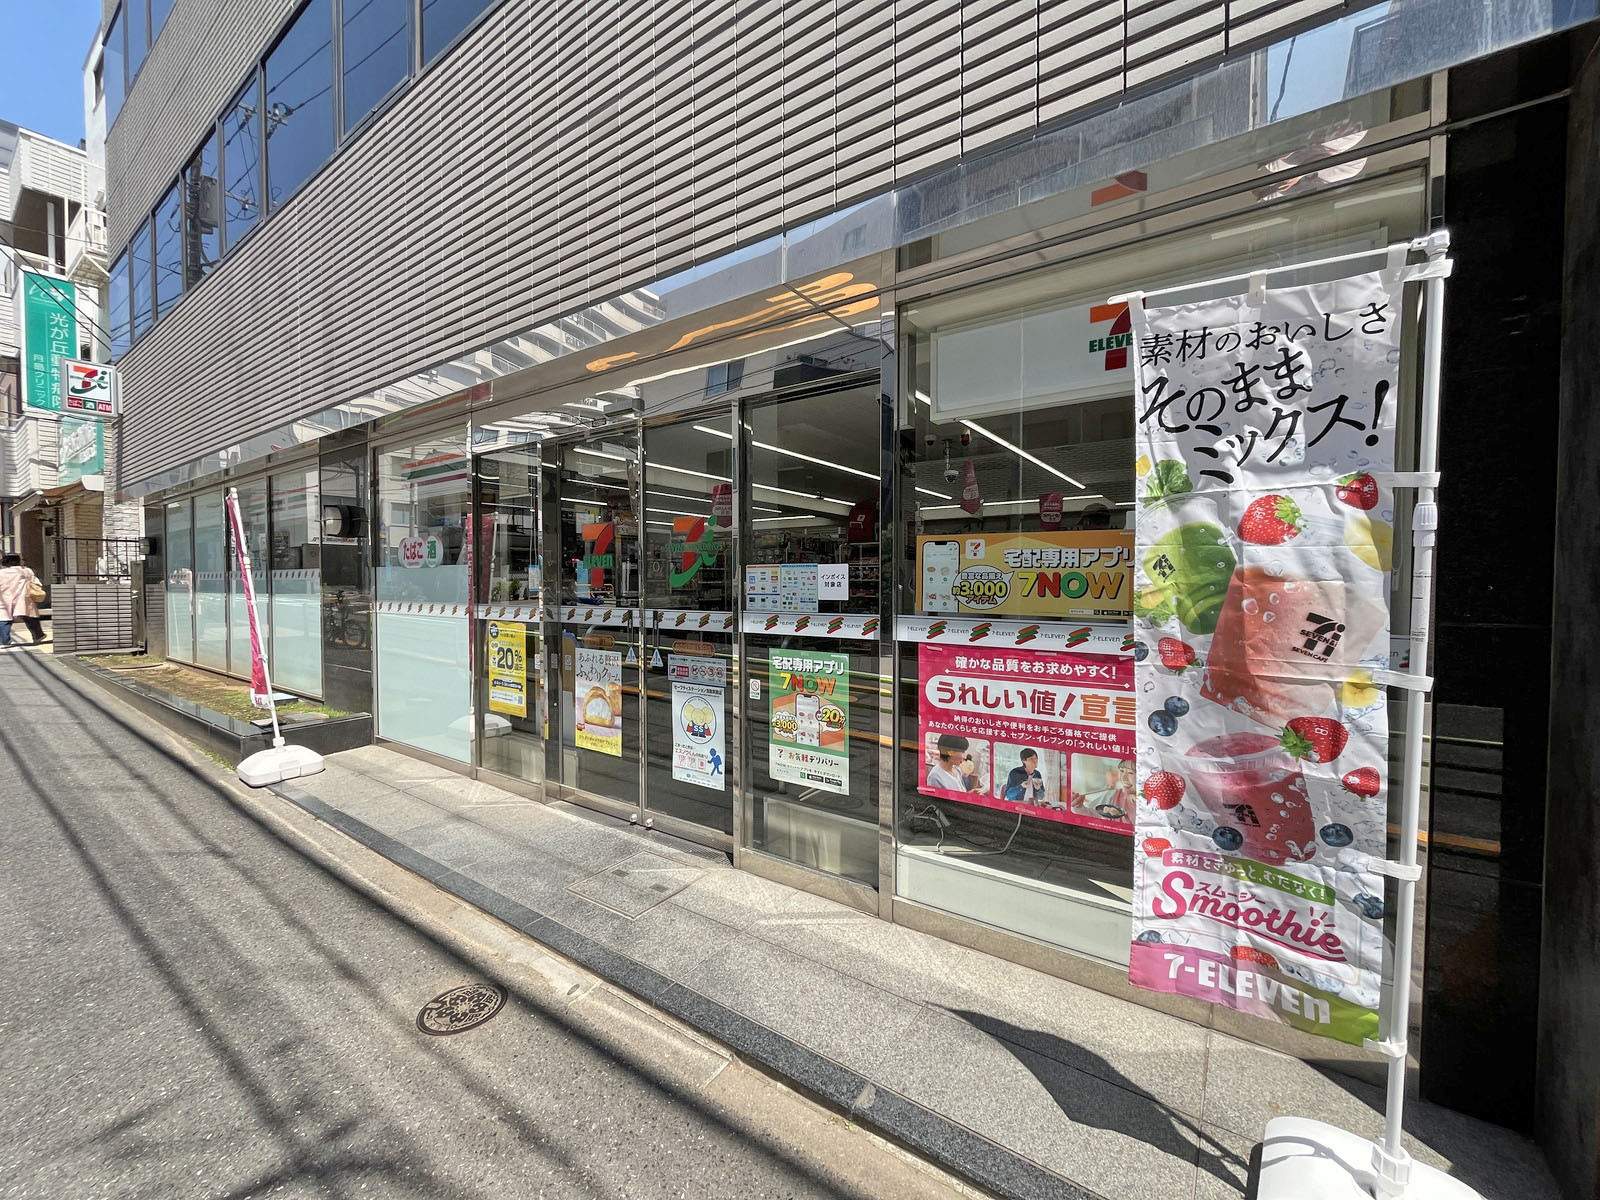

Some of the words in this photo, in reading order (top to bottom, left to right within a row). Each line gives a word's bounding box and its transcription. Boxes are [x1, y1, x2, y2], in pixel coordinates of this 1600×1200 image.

[1089, 332, 1133, 353] ELEVE
[1140, 302, 1388, 368] 素材のおいしさ
[1139, 348, 1312, 433] そのまま
[98, 403, 112, 412] ATM
[1193, 379, 1390, 484] ミックス!
[403, 541, 423, 560] たばこ
[427, 541, 437, 559] 酒
[1003, 547, 1136, 569] 宅配専用アプリ
[1017, 571, 1124, 599] 7NOW
[966, 595, 997, 605] アイテム
[1292, 646, 1313, 658] SEVEN
[773, 656, 844, 675] 宅配専用アプリ
[955, 656, 1117, 680] 確かな品質をお求めやすく!
[780, 672, 836, 695] 7NOW
[953, 714, 1117, 742] 納得のおいしさや便利をお手ごろ価格でご提供
[788, 752, 839, 767] お気軽デリバリー
[1196, 881, 1266, 904] スムージー
[1152, 871, 1344, 955] Smoothie
